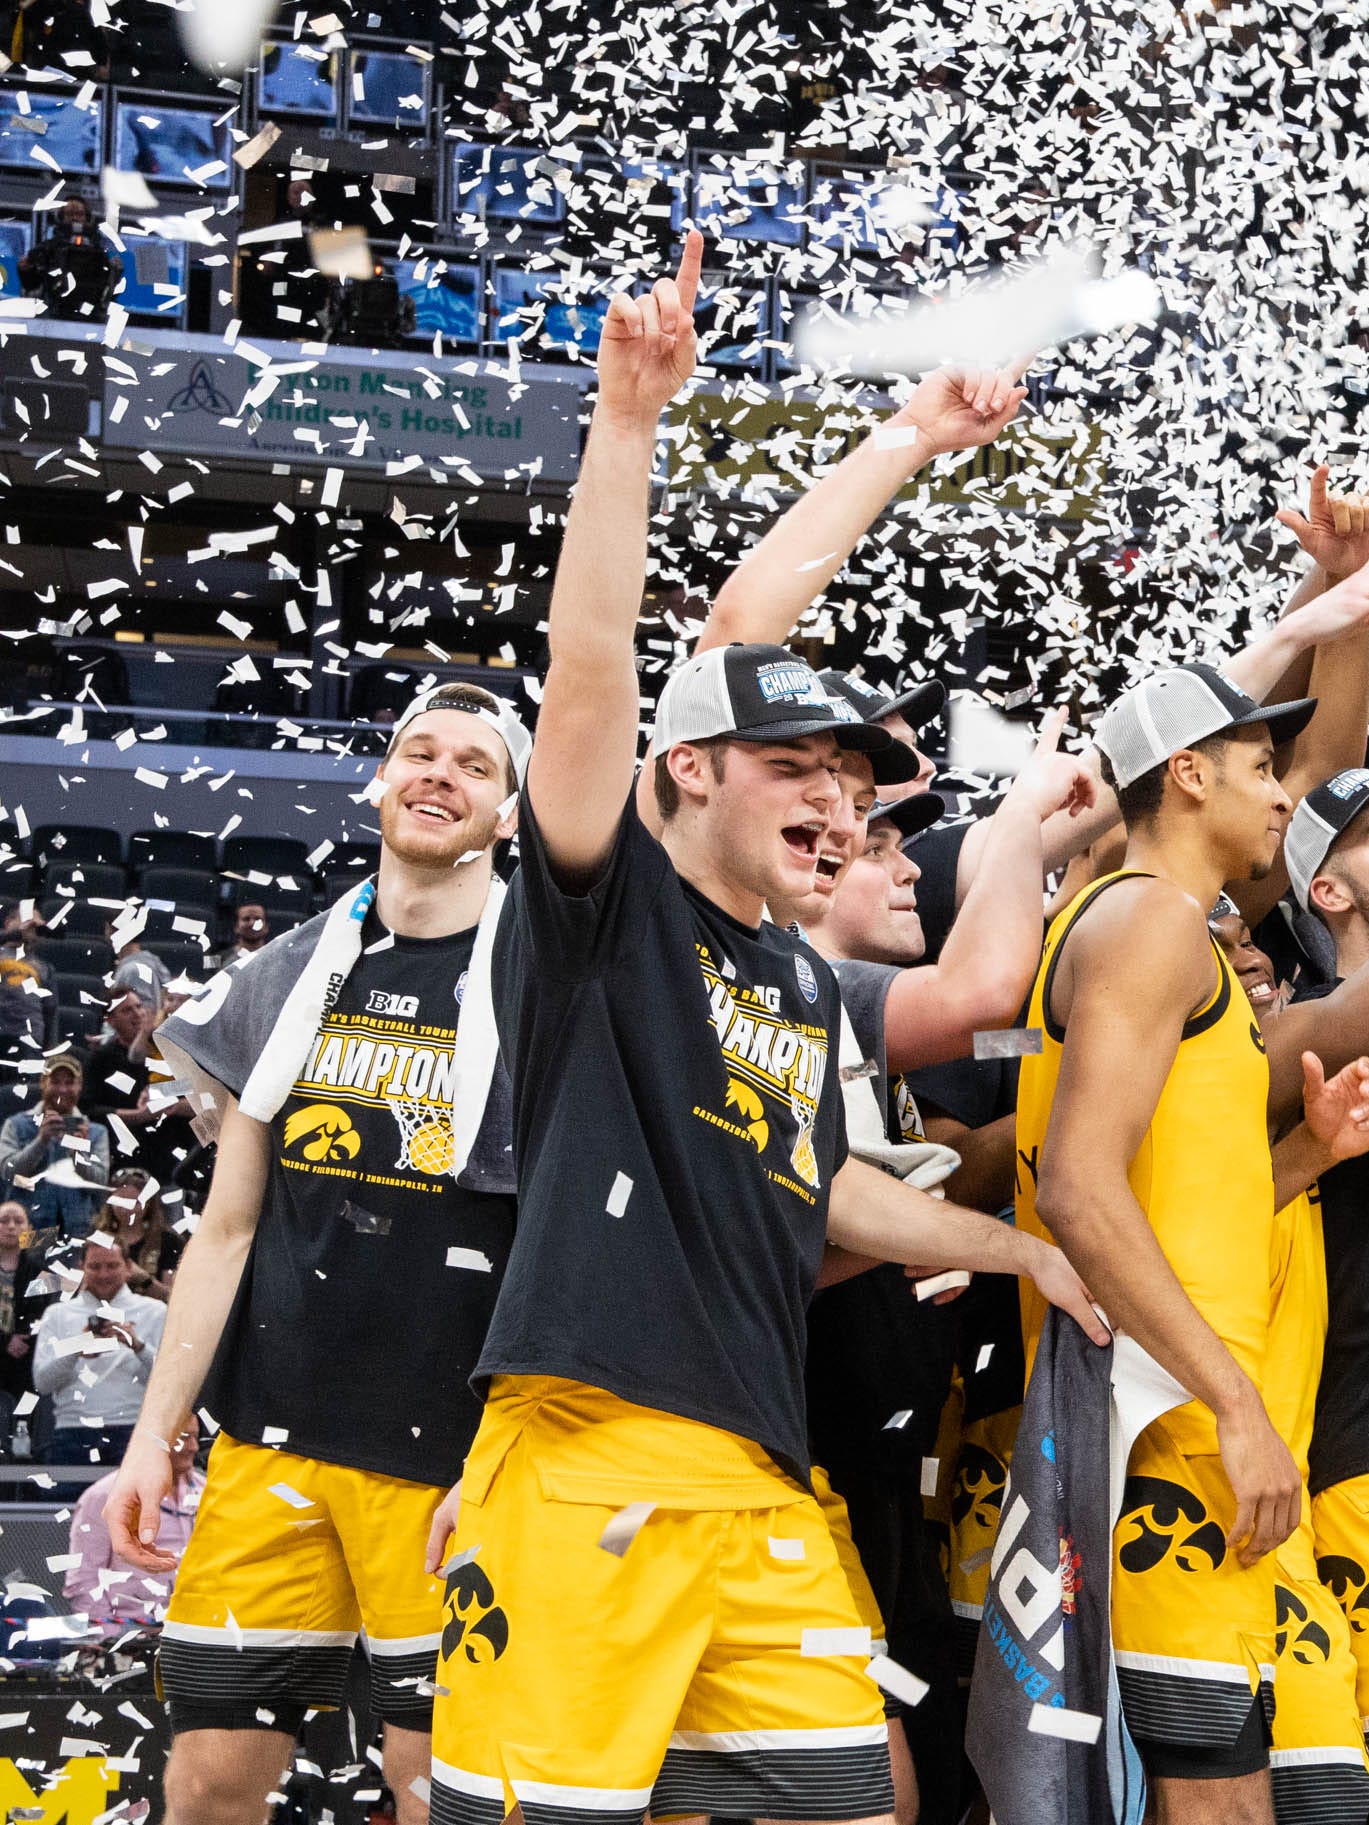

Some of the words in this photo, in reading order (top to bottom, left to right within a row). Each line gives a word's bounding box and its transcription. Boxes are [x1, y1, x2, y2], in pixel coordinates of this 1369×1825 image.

[246, 398, 391, 430] hildren's
[401, 406, 522, 439] Hospital
[420, 1025, 457, 1039] TOURN
[299, 1035, 457, 1104] HAMPION
[692, 1106, 752, 1142] GAINBRIDGE
[985, 1600, 1050, 1701] BASKET
